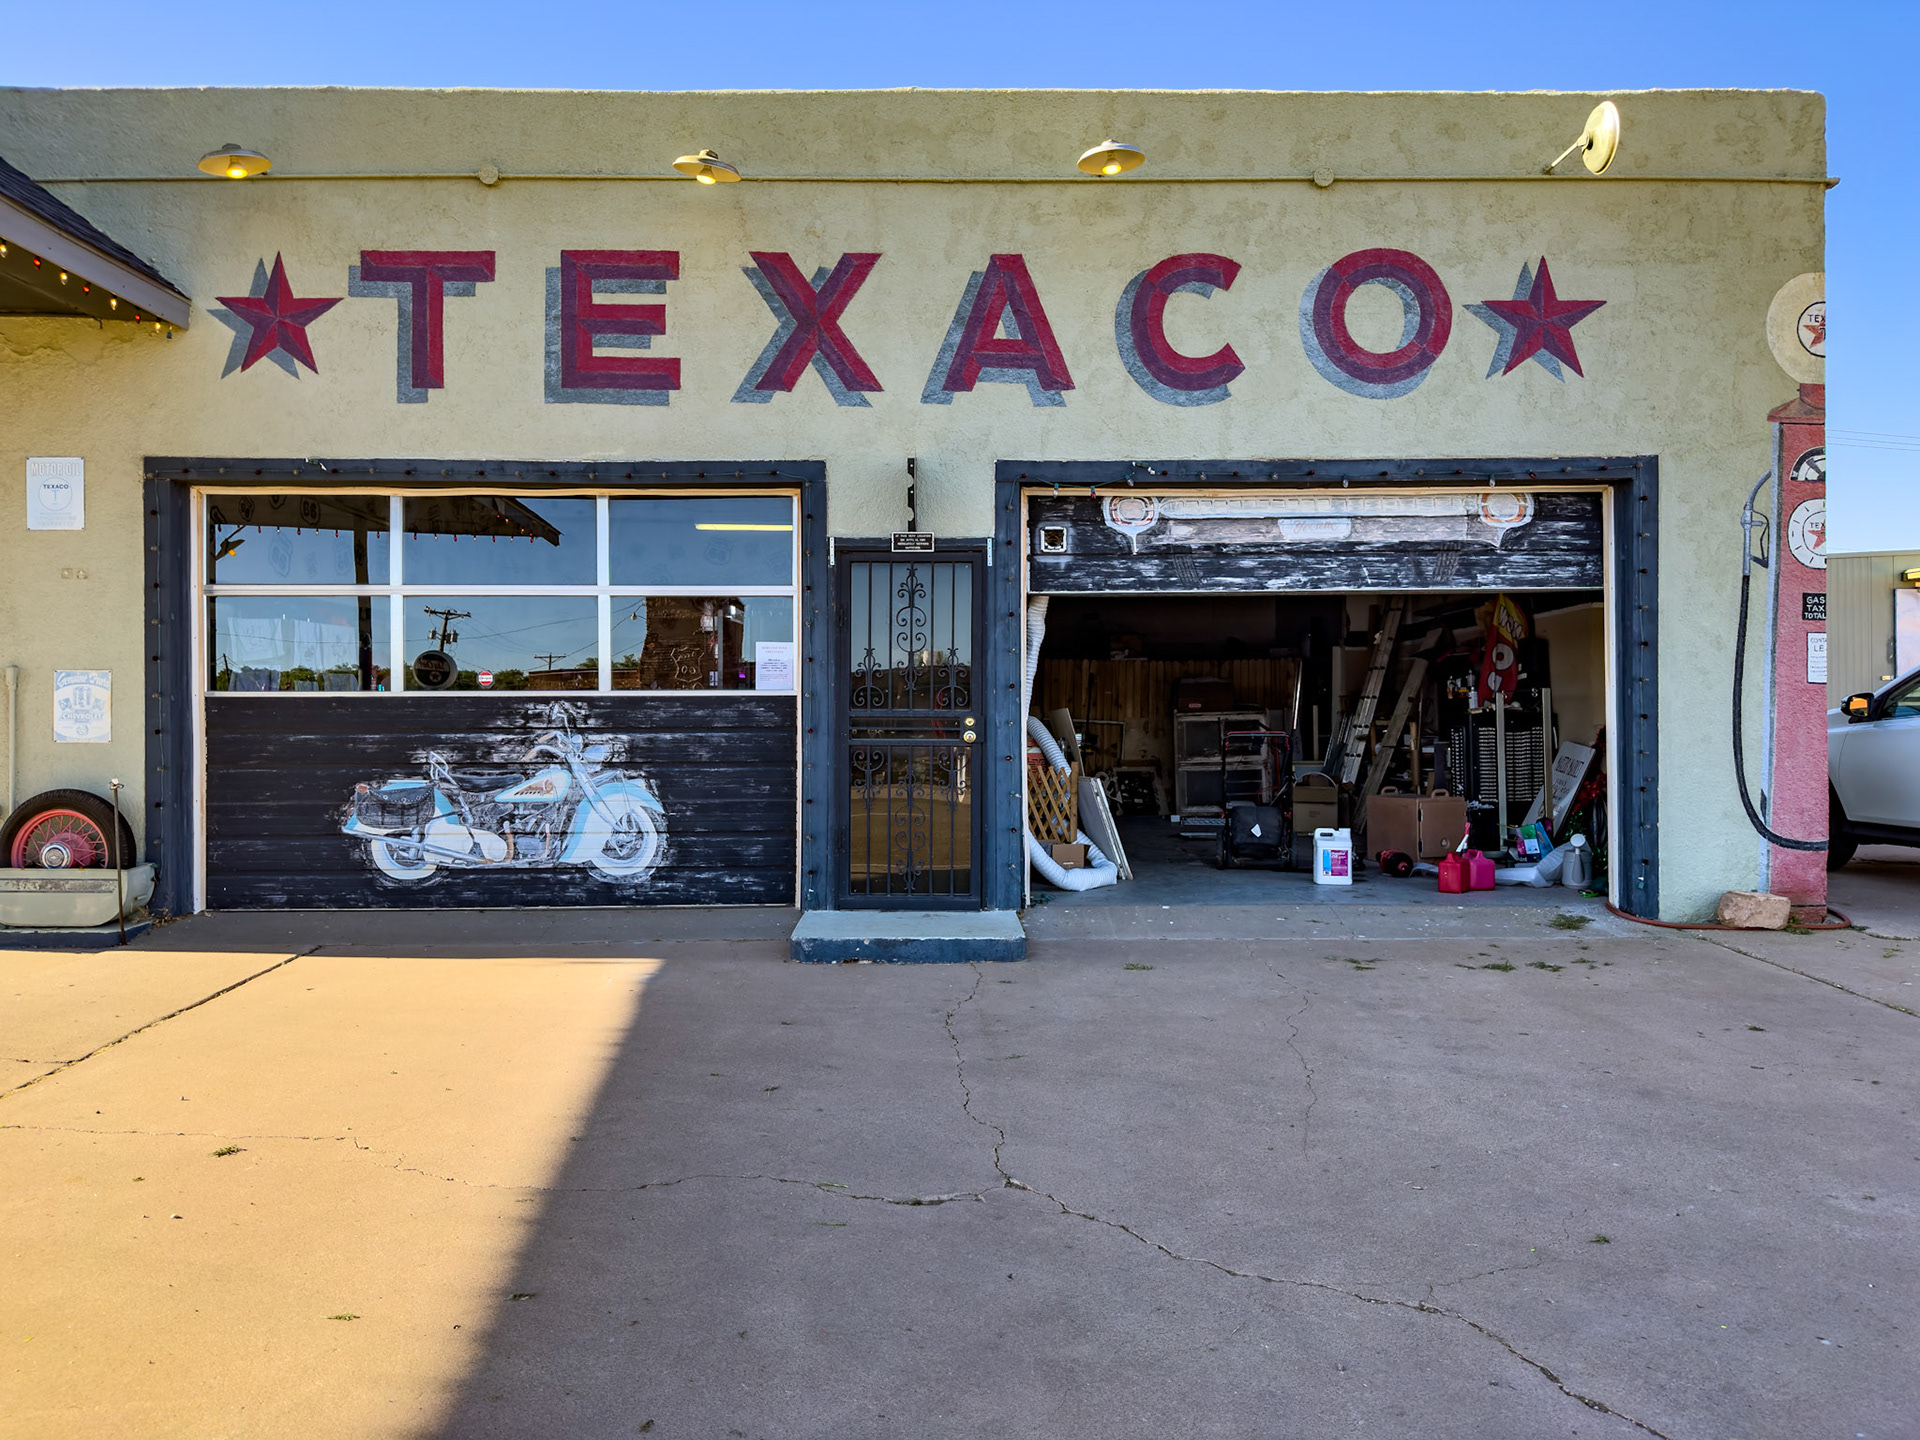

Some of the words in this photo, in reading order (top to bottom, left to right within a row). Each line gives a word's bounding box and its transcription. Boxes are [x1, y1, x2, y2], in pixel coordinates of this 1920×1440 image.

[348, 248, 1453, 406] TEXACO
[31, 463, 62, 476] MOTOR
[65, 463, 81, 476] OIL
[1806, 596, 1825, 604] GAS
[1806, 604, 1825, 612] TAX
[61, 712, 104, 720] CHEVROLET
